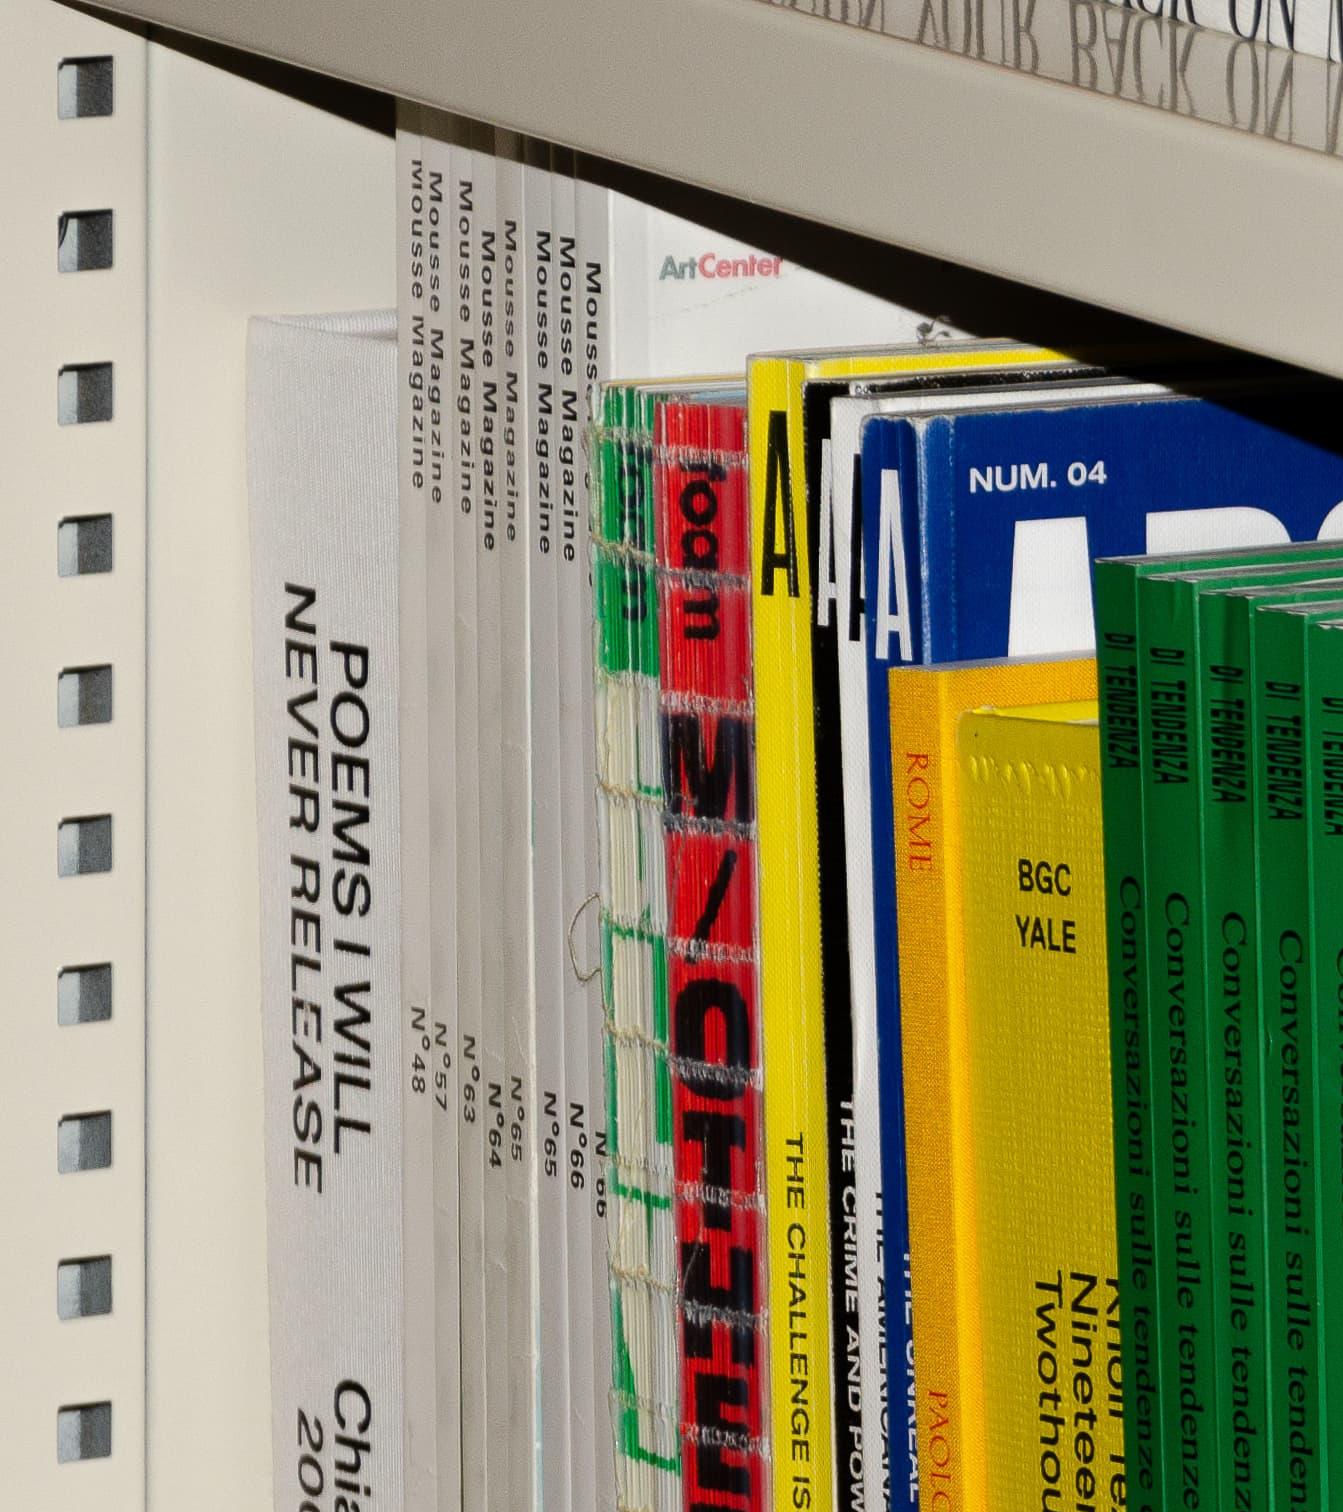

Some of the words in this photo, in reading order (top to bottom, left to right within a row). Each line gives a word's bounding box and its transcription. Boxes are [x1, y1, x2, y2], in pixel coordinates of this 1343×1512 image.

[411, 160, 424, 299] Mousse
[429, 171, 443, 313] Mousse
[458, 179, 473, 323] Mousse
[480, 229, 497, 369] Mousse
[504, 218, 518, 358] Mousse
[535, 230, 551, 370] Mousse
[659, 252, 784, 282] ArtCenter
[558, 235, 576, 377] Mousse
[408, 316, 426, 490] Magazine
[427, 329, 446, 506] Magazine
[457, 338, 476, 515] Magazine
[481, 380, 499, 552] Magazine
[503, 370, 520, 543] Magazine
[535, 383, 554, 556] Magazine
[558, 389, 579, 563] Magazine
[760, 410, 801, 599] A
[968, 463, 1058, 494] NUM.
[1066, 460, 1108, 489] 04
[875, 469, 913, 662] A
[284, 581, 320, 833] NEVER
[329, 640, 371, 918] POEMS
[904, 750, 933, 872] ROME
[334, 940, 371, 957] I
[1015, 914, 1077, 954] YALE
[1017, 857, 1072, 898] BGC
[290, 855, 323, 1194] RELEASE
[333, 980, 371, 1154] WILL
[785, 1132, 806, 1210] THE
[842, 1185, 859, 1314] CRIME
[786, 1222, 811, 1462] CHALLENGE
[845, 1328, 863, 1413] AND
